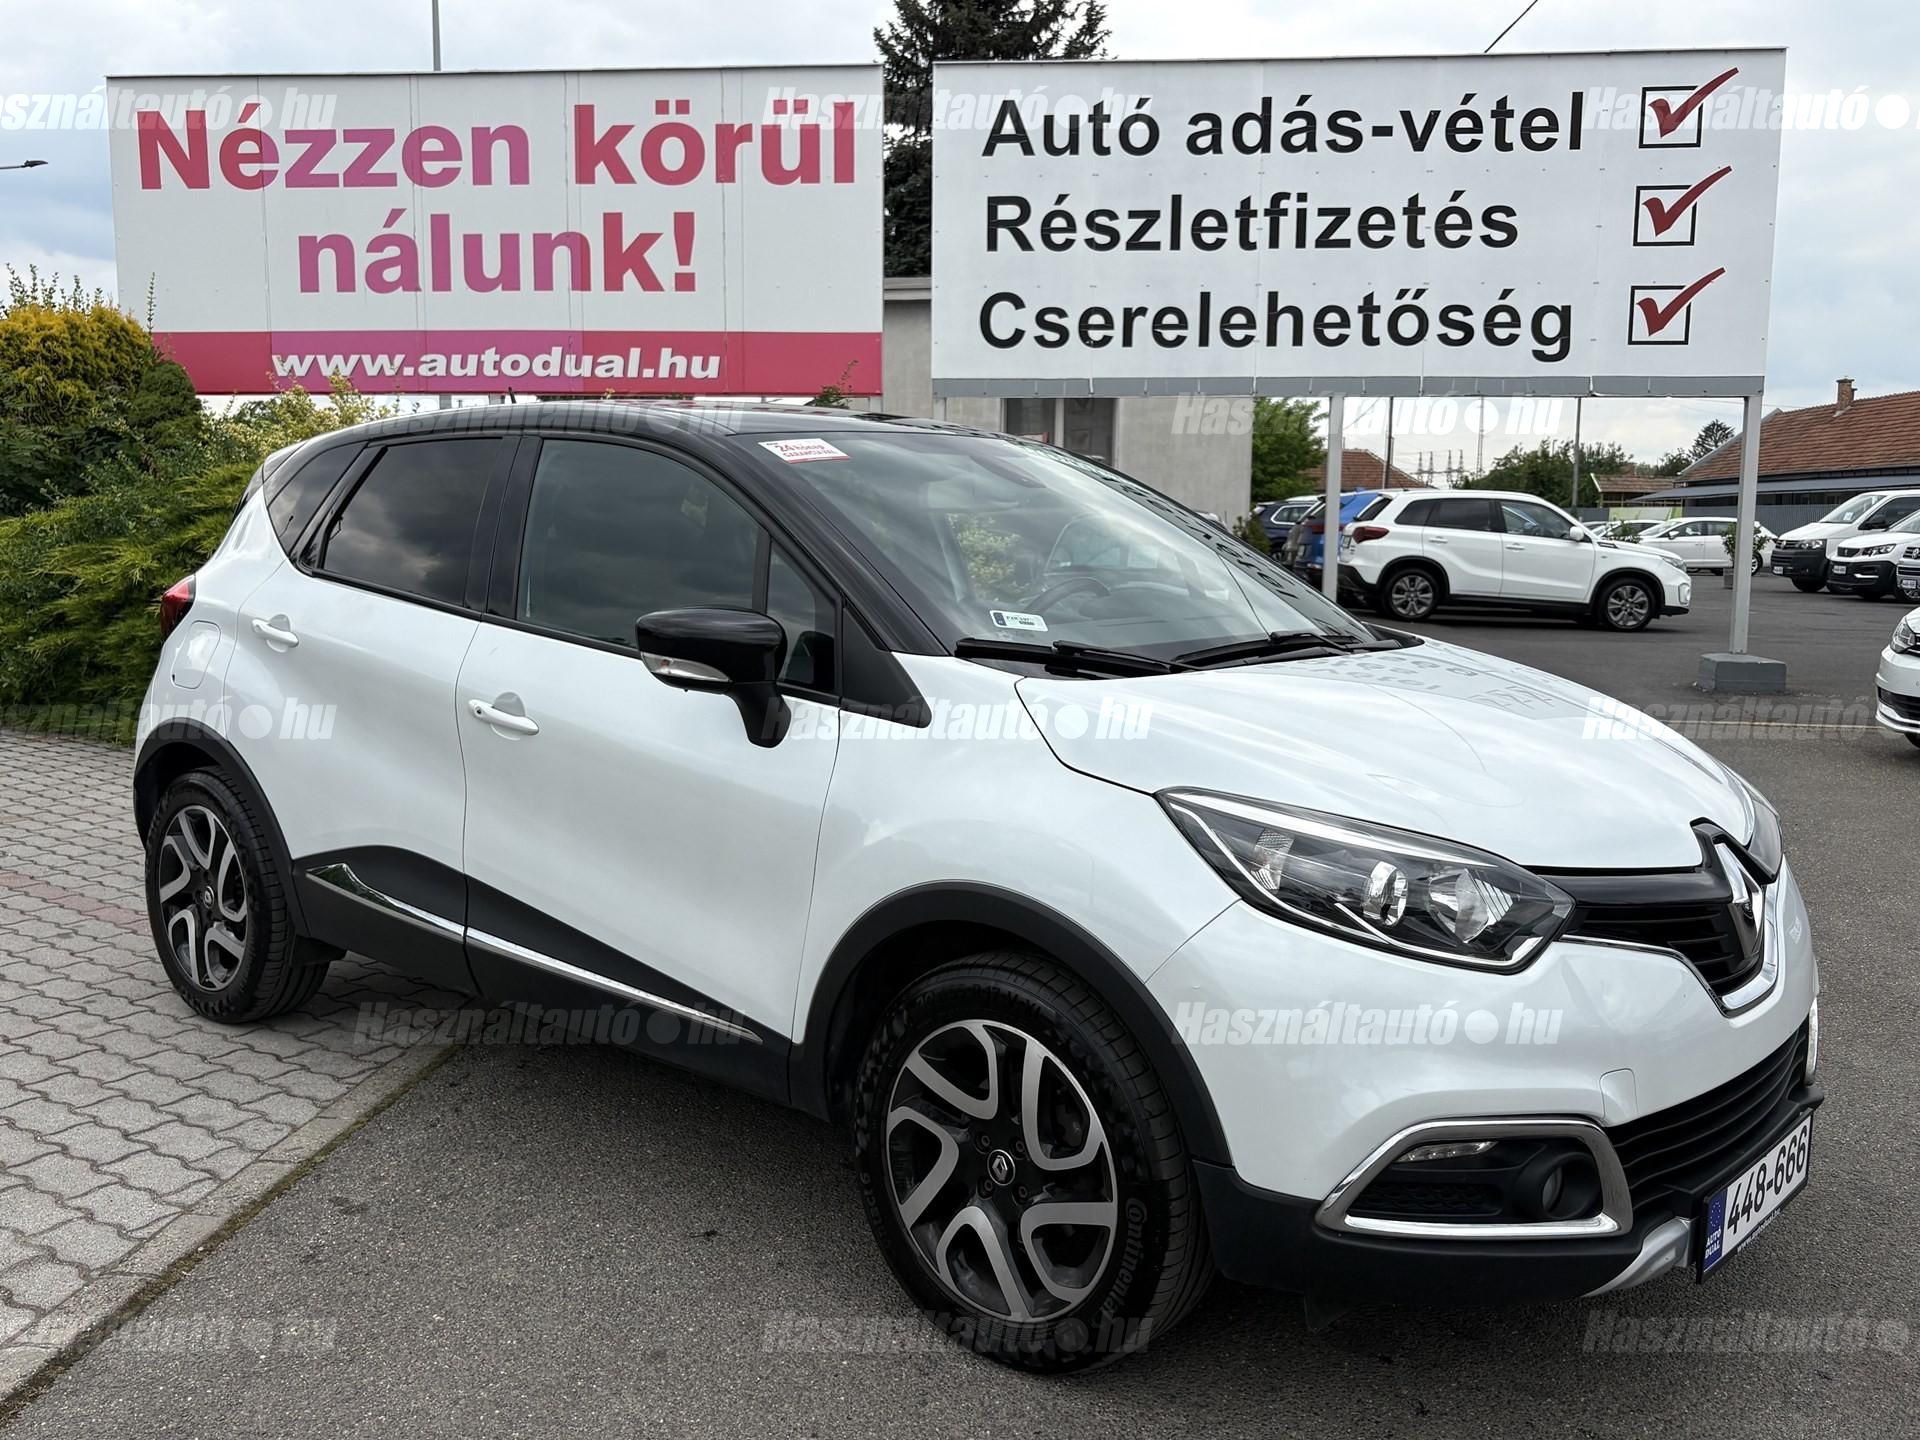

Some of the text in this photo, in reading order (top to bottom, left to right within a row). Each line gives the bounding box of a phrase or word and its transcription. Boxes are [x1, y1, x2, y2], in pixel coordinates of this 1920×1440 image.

[136, 98, 857, 191] Nézzen körül
[982, 91, 1584, 157] Autó adás-vétel
[298, 208, 697, 294] nálunk!
[987, 190, 1518, 252] Részletfizetés
[979, 288, 1572, 363] Cserelehetőség
[271, 345, 721, 382] www.autodual.hu
[1727, 1124, 1807, 1235] 448-666
